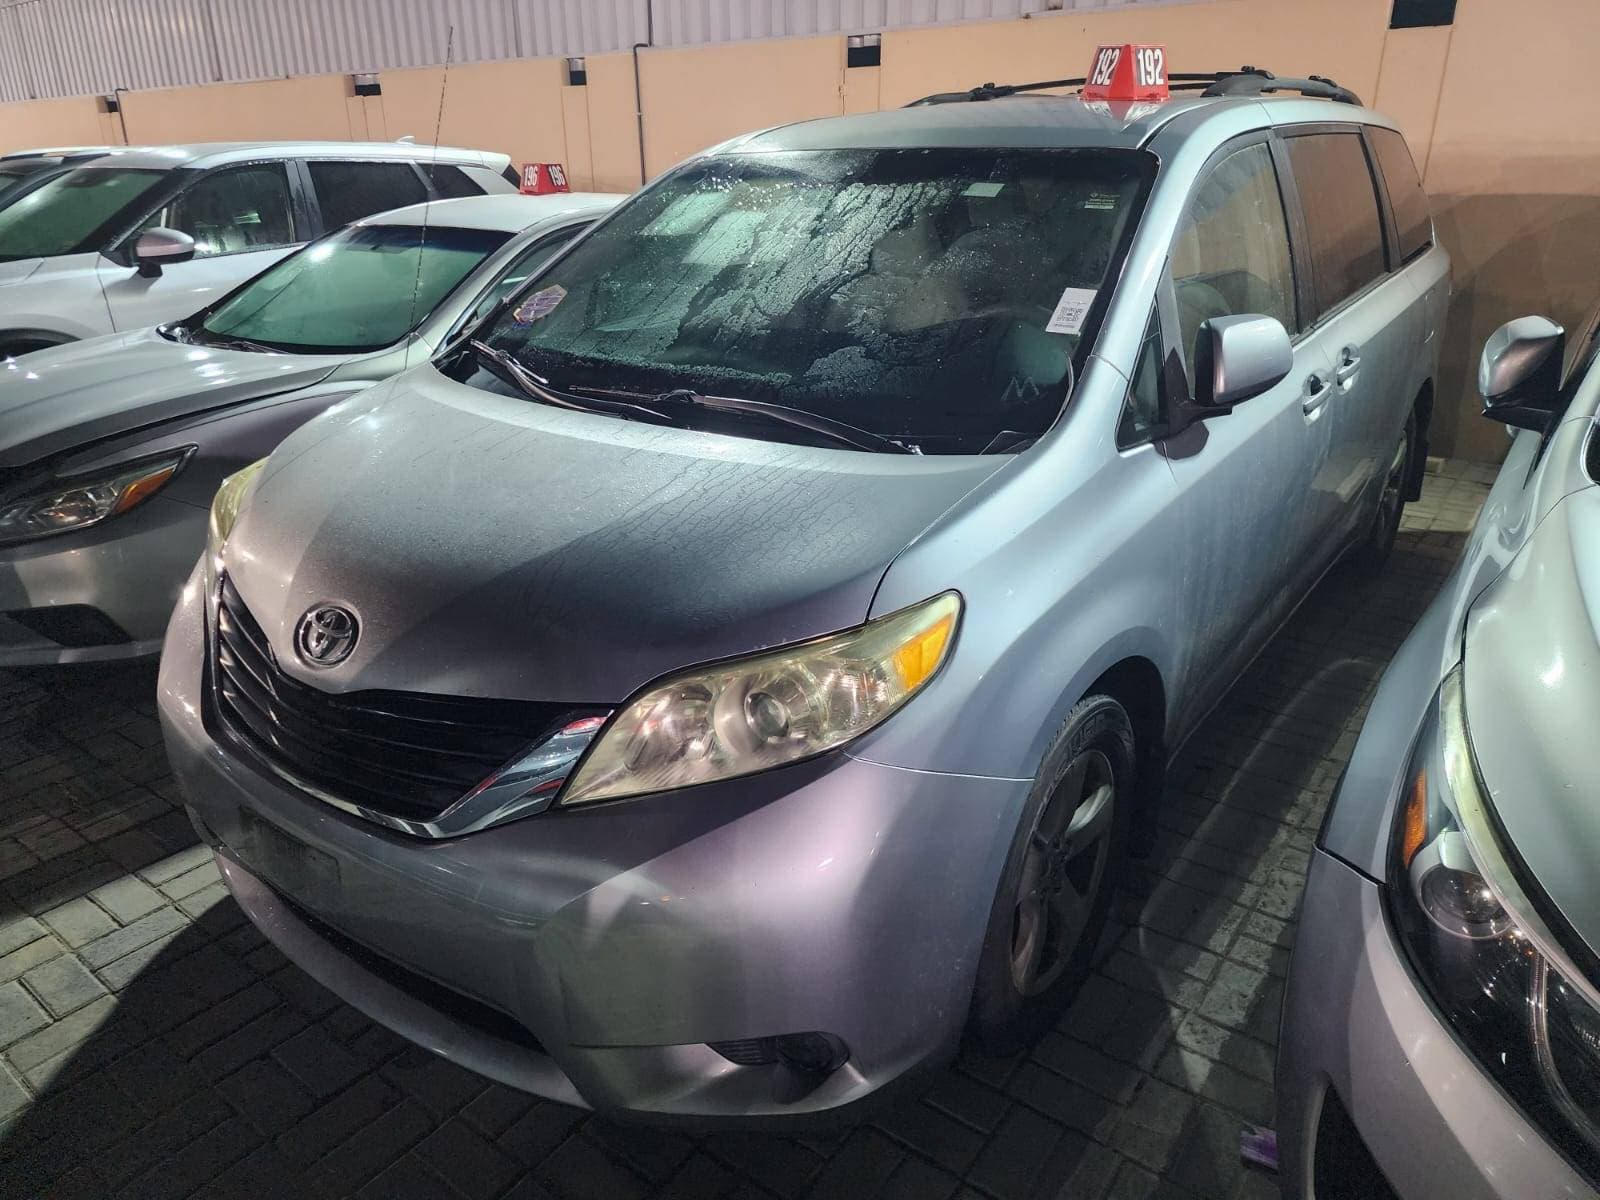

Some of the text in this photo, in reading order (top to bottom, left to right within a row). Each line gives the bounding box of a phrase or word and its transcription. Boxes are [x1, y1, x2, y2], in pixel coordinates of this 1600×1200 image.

[1091, 48, 1120, 85] 192
[1137, 48, 1164, 86] 192
[524, 165, 538, 186] 196
[548, 165, 566, 186] 196
